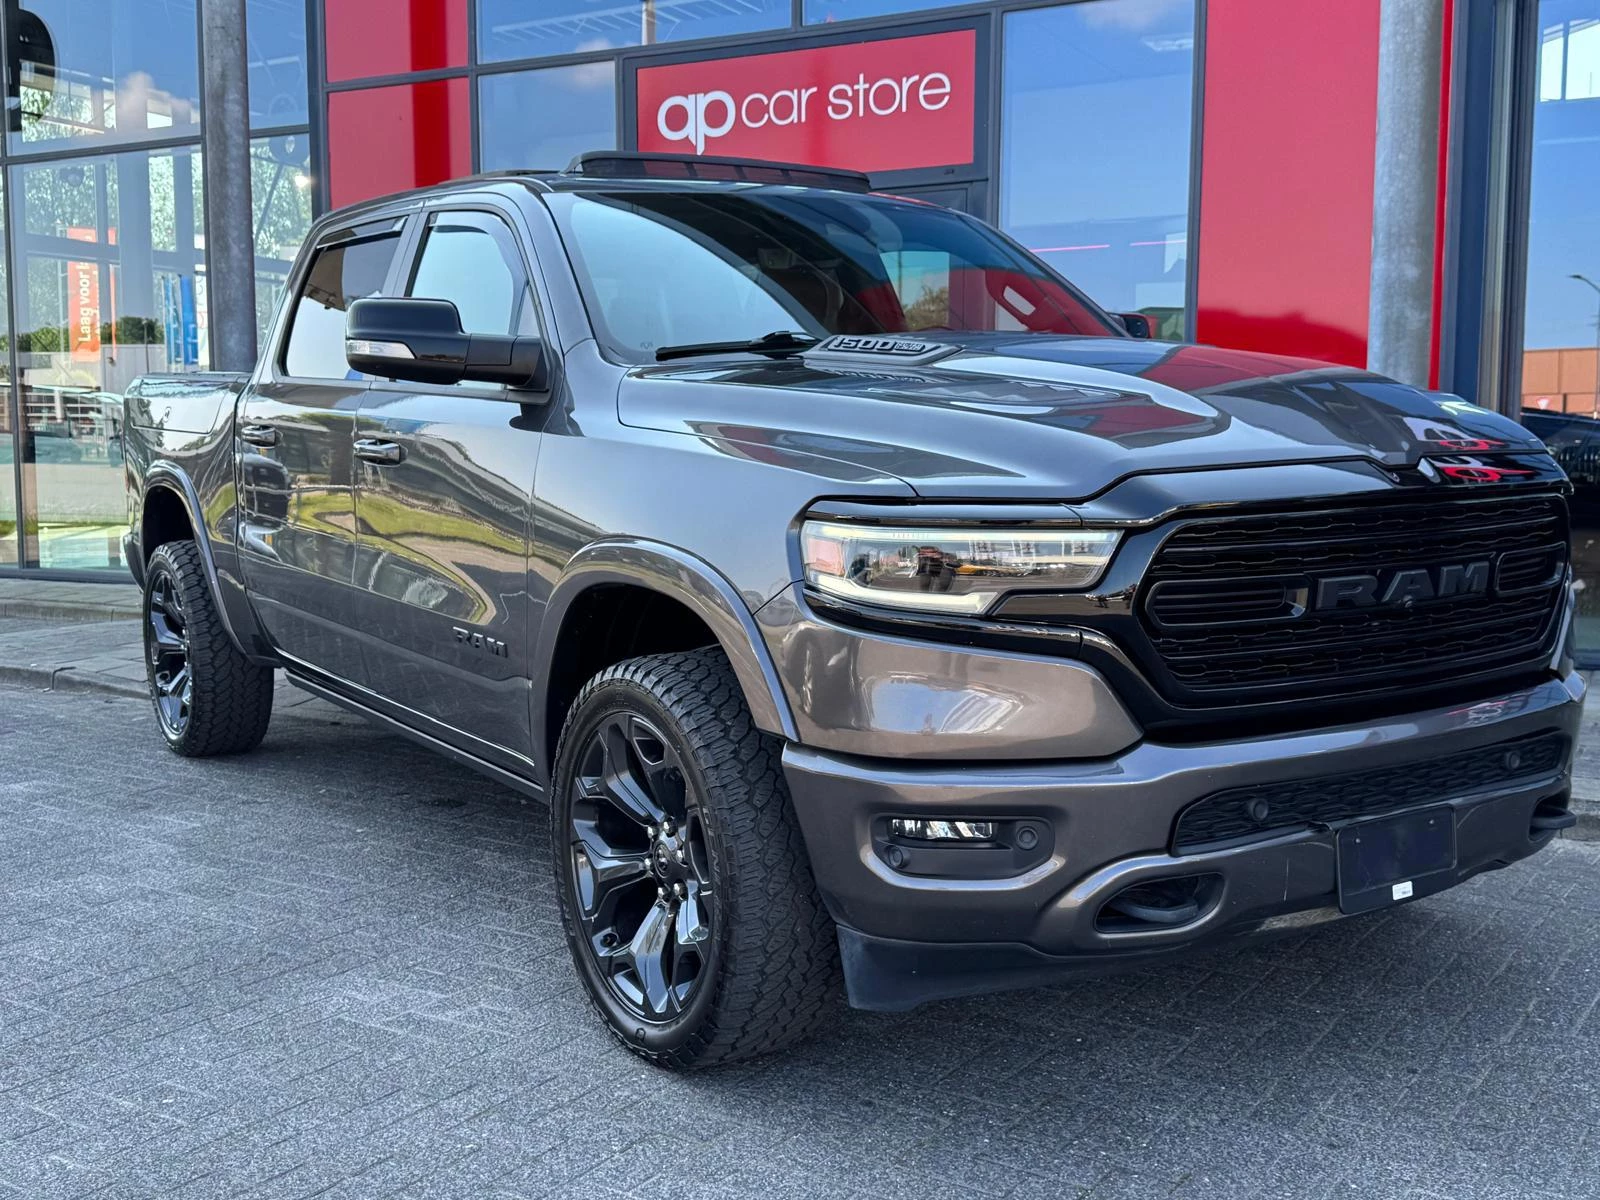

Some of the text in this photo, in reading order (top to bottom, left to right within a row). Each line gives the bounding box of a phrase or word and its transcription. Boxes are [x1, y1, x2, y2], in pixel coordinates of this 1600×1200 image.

[657, 72, 951, 156] ap car store
[79, 272, 91, 305] voor
[78, 306, 93, 342] Laag
[828, 337, 894, 352] 1500
[1315, 560, 1490, 610] RAM
[452, 626, 509, 659] RAM
